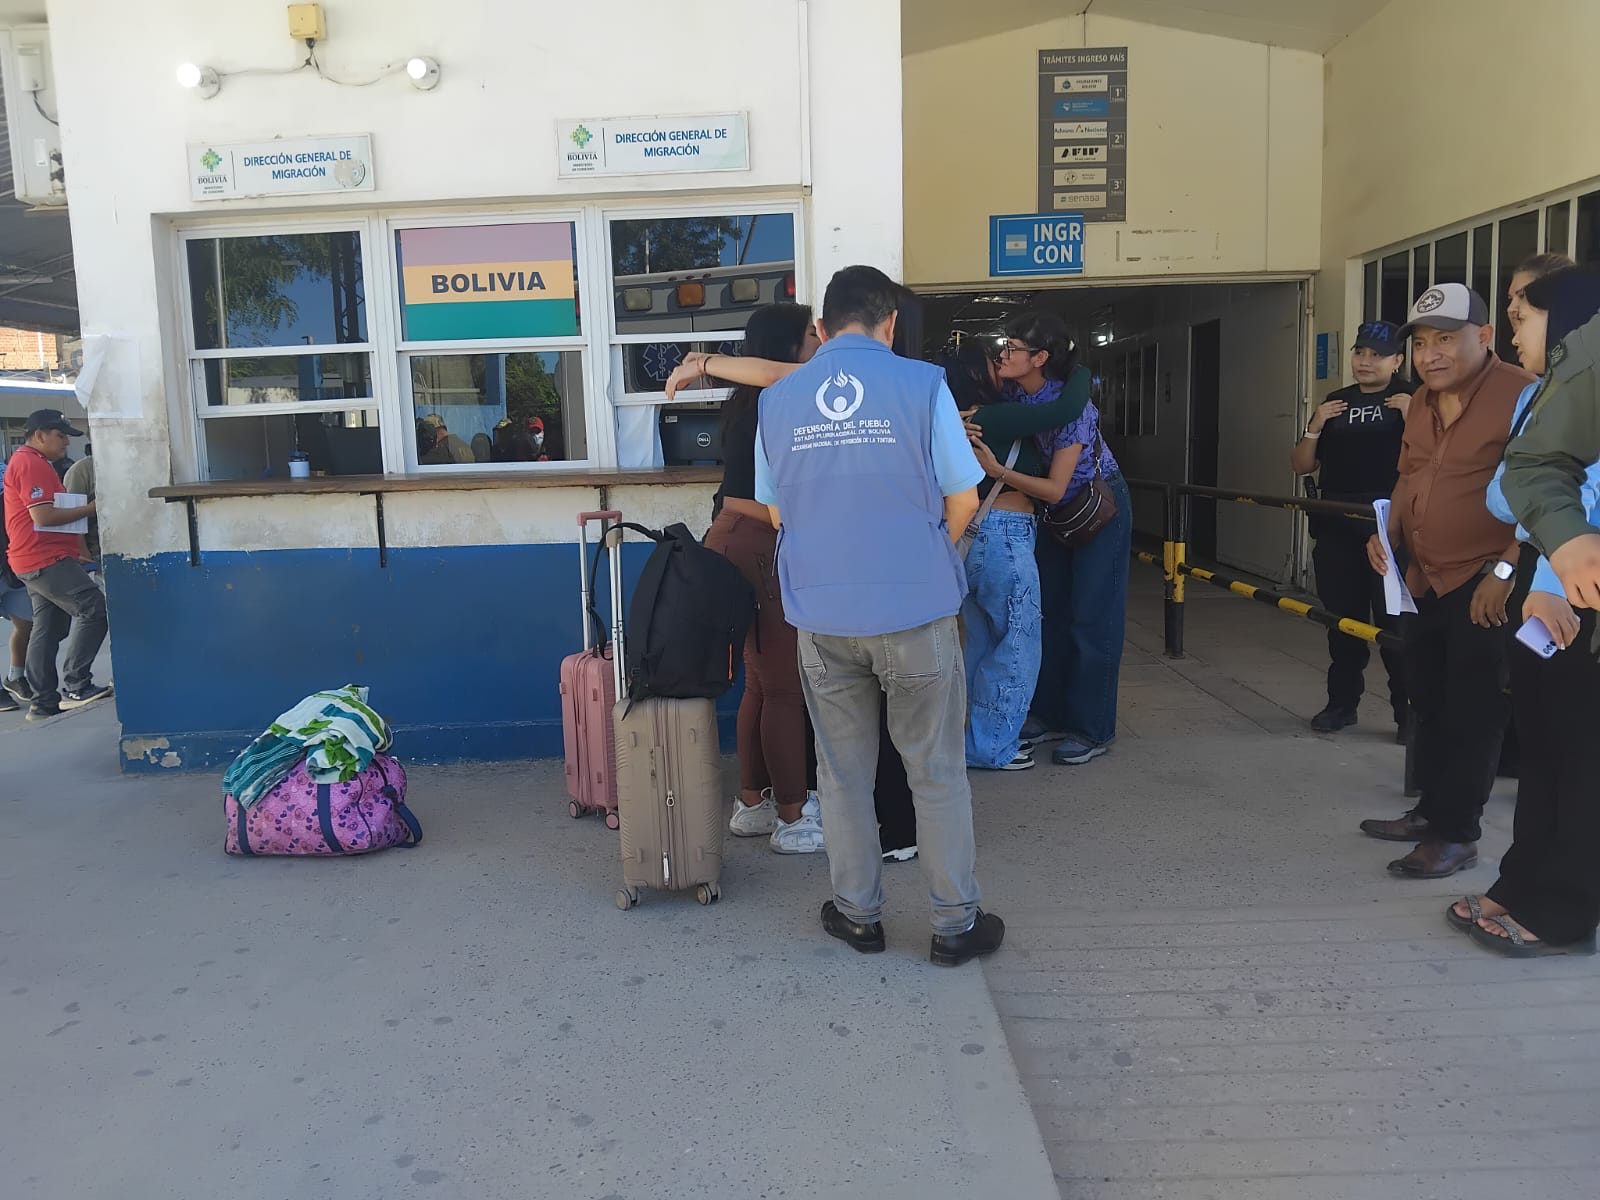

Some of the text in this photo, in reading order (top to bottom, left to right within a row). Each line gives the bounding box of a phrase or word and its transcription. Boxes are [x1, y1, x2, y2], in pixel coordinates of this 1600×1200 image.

[1043, 52, 1125, 64] TRÁMITES INGRESO PAÍS
[615, 128, 727, 144] DIRECCIÓN GENERAL DE
[243, 150, 351, 167] DIRECCIÓN GENERAL DE
[567, 153, 598, 161] BOLIVIA
[643, 144, 700, 157] MIGRACIÓN
[198, 176, 228, 184] BOLIVIA
[271, 166, 326, 180] MIGRACIÓN
[1033, 222, 1081, 242] INGR
[1033, 244, 1073, 264] CON
[431, 271, 546, 294] BOLIVIA
[1363, 323, 1389, 341] PFA
[1349, 405, 1383, 424] PFA
[793, 419, 890, 436] DEFENSORÍA DEL PUEBLO
[794, 433, 814, 442] ESTADO
